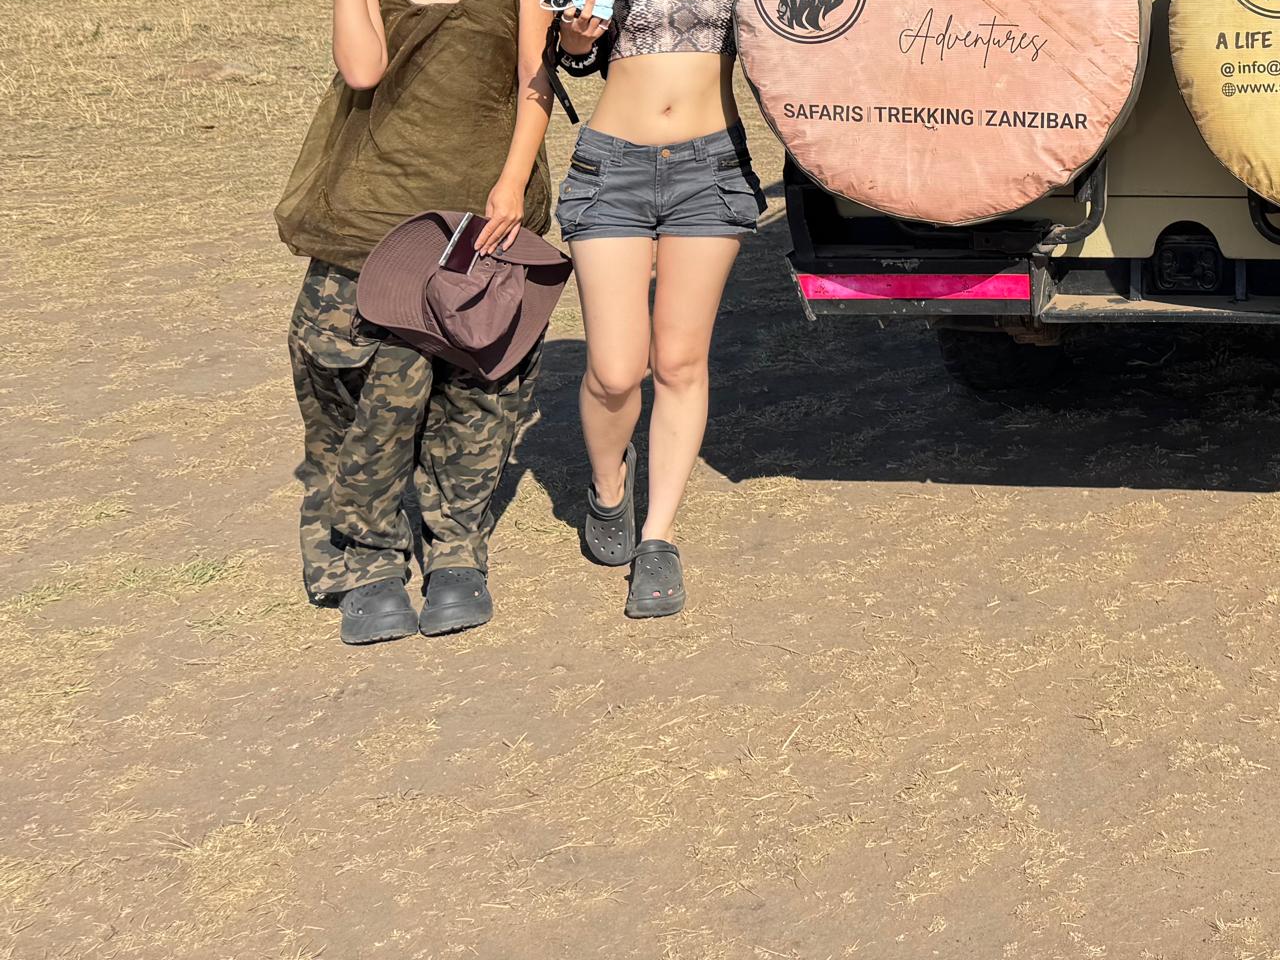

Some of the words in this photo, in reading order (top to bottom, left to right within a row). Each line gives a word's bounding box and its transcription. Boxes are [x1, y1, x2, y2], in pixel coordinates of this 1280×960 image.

[898, 7, 1048, 69] Adventures
[1215, 31, 1229, 50] A
[1234, 31, 1273, 49] LIFE
[782, 102, 864, 123] SAFARIS
[873, 105, 975, 126] TREKKING
[984, 109, 1088, 130] ZANZIBAR
